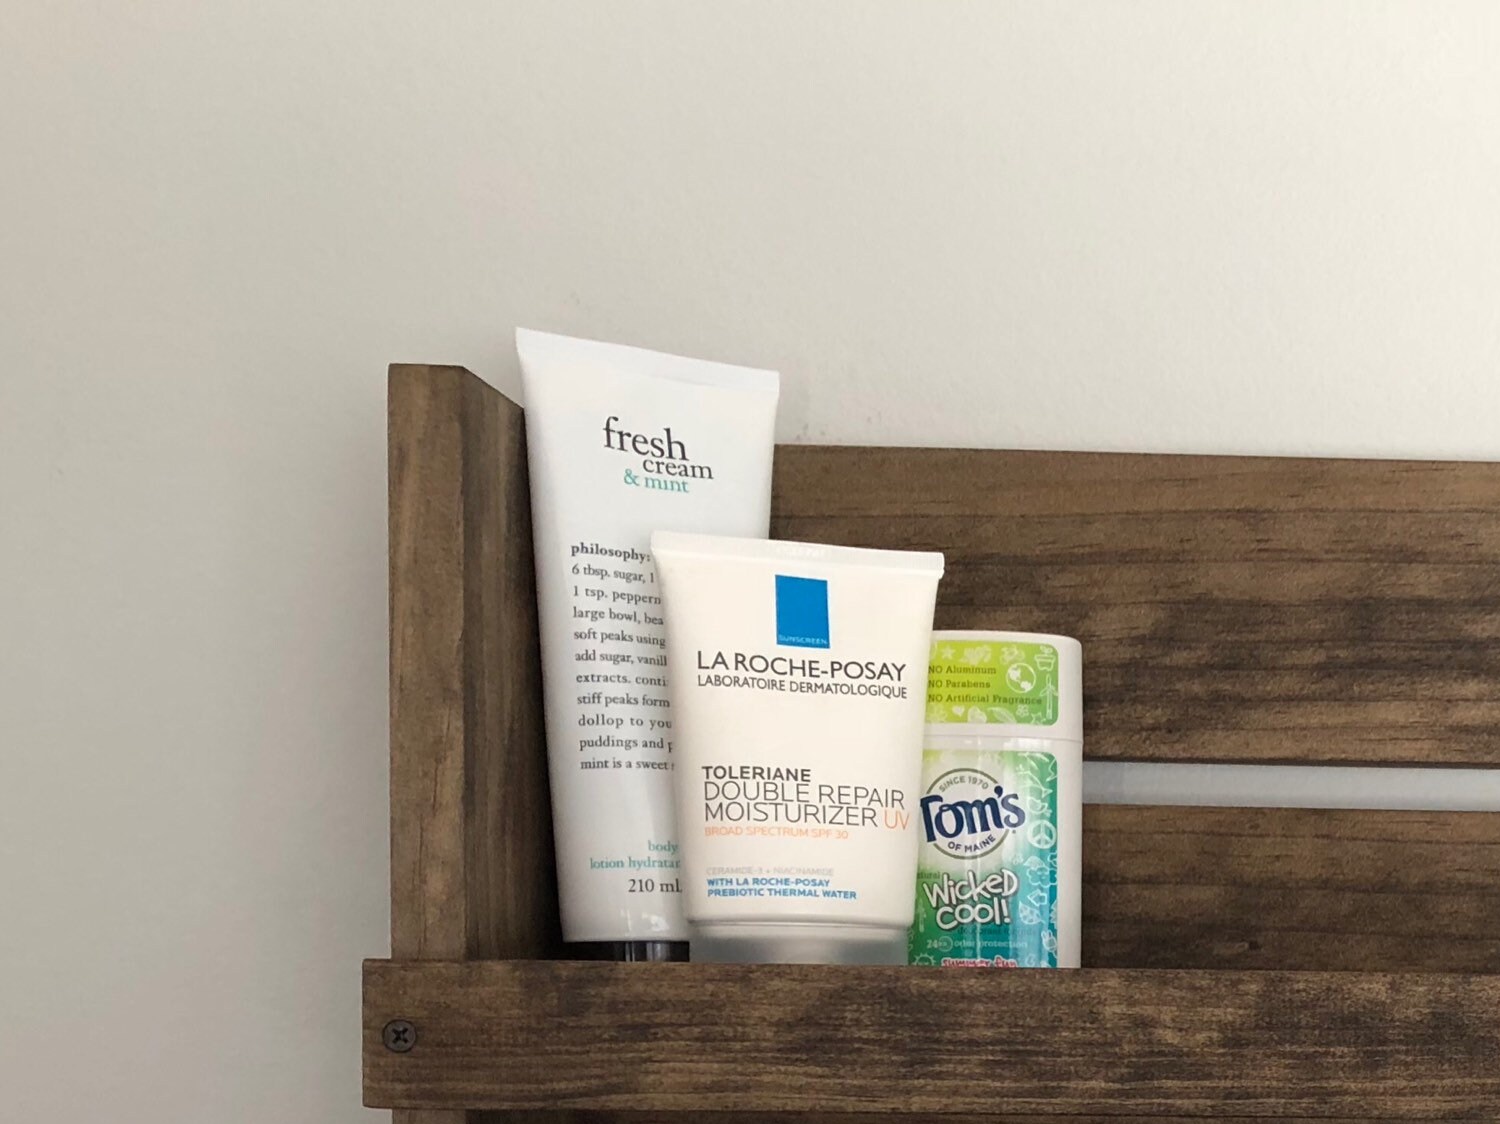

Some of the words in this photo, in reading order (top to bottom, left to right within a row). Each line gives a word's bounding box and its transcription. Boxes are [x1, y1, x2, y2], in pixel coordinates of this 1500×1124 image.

[603, 416, 690, 461] fresh
[643, 459, 714, 479] cream
[623, 469, 640, 486] &
[644, 476, 690, 493] mint
[571, 542, 651, 563] philosophy:
[572, 563, 580, 575] 6
[583, 564, 610, 580] tbsp.
[613, 570, 646, 584] sugar,
[585, 587, 608, 601] tsp.
[573, 606, 605, 621] large
[609, 608, 641, 624] bowl,
[574, 628, 597, 640] soft
[600, 630, 634, 643] peaks
[636, 634, 666, 649] using
[575, 649, 596, 661] add
[600, 654, 634, 665] sugar,
[697, 650, 730, 671] LA
[734, 652, 906, 682] ROCHE-POSAY
[929, 665, 943, 674] NO
[946, 665, 996, 675] Aluminum
[576, 673, 631, 684] extracts.
[636, 676, 669, 687] conti
[697, 674, 786, 692] LABORATOIRE
[789, 681, 907, 699] DERMATOLOGIQUE
[928, 679, 943, 688] NO
[946, 679, 991, 688] Parabens
[577, 692, 602, 704] stiff
[605, 693, 638, 707] peaks
[642, 694, 670, 708] form
[928, 694, 943, 703] NO
[946, 694, 989, 703] Artificial
[993, 695, 1042, 705] Fragrance
[578, 714, 624, 728] dollop
[630, 717, 643, 726] to
[579, 735, 638, 751] puddings
[642, 738, 664, 748] and
[581, 758, 609, 769] mint
[613, 757, 622, 768] is
[625, 760, 632, 768] a
[636, 760, 669, 770] sweet
[701, 765, 811, 782] TOLERIANE
[939, 776, 965, 792] SINCE
[968, 776, 989, 790] 1970
[704, 781, 810, 803] DOUBLE
[818, 784, 905, 810] REPAIR
[705, 801, 878, 828] MOISTURIZER
[884, 809, 910, 830] UV
[920, 785, 1025, 842] Tom's
[704, 826, 743, 837] BROAD
[746, 827, 808, 838] SPECTRUM
[812, 828, 832, 838] SPF
[835, 830, 848, 839] 30
[648, 840, 678, 855] body
[948, 841, 962, 851] OF
[964, 834, 996, 853] MAINE
[590, 857, 624, 869] lotion
[628, 879, 654, 893] 210
[707, 878, 733, 886] WITH
[736, 878, 749, 886] LA
[752, 878, 830, 887] ROCHE-POSAY
[707, 888, 764, 897] PREBIOTIC
[767, 888, 819, 897] THERMAL
[822, 890, 857, 899] WATER
